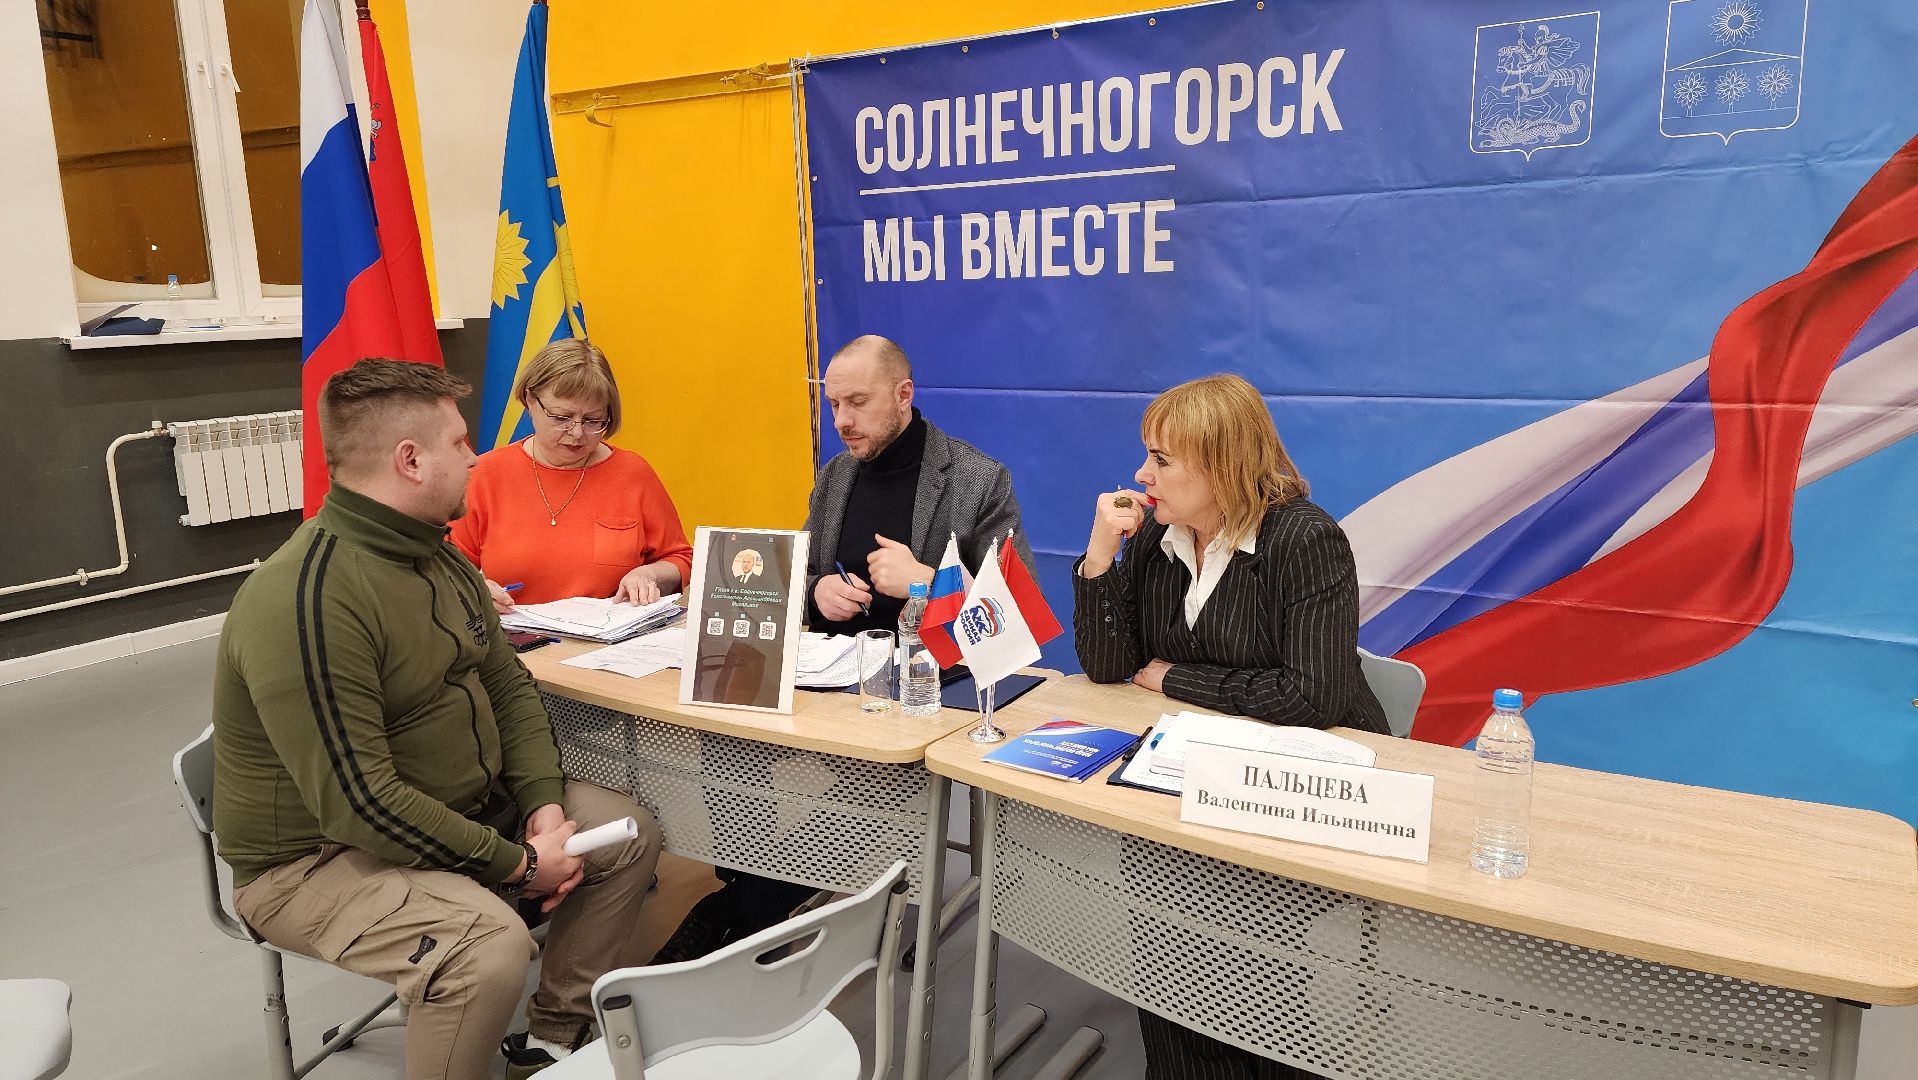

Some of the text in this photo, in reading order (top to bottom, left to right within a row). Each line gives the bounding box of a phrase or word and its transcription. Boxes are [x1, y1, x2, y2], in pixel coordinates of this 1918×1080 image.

[855, 48, 1346, 175] СОЛНЕЧНОГОРСК
[863, 199, 1176, 283] МЫ ВМЕСТЕ
[960, 612, 976, 646] РОССИЯ
[964, 610, 981, 643] ЕДИНАЯ
[1243, 765, 1369, 804] ПАЛЬЦЕВА
[1197, 789, 1417, 839] Валентина Ильинична
